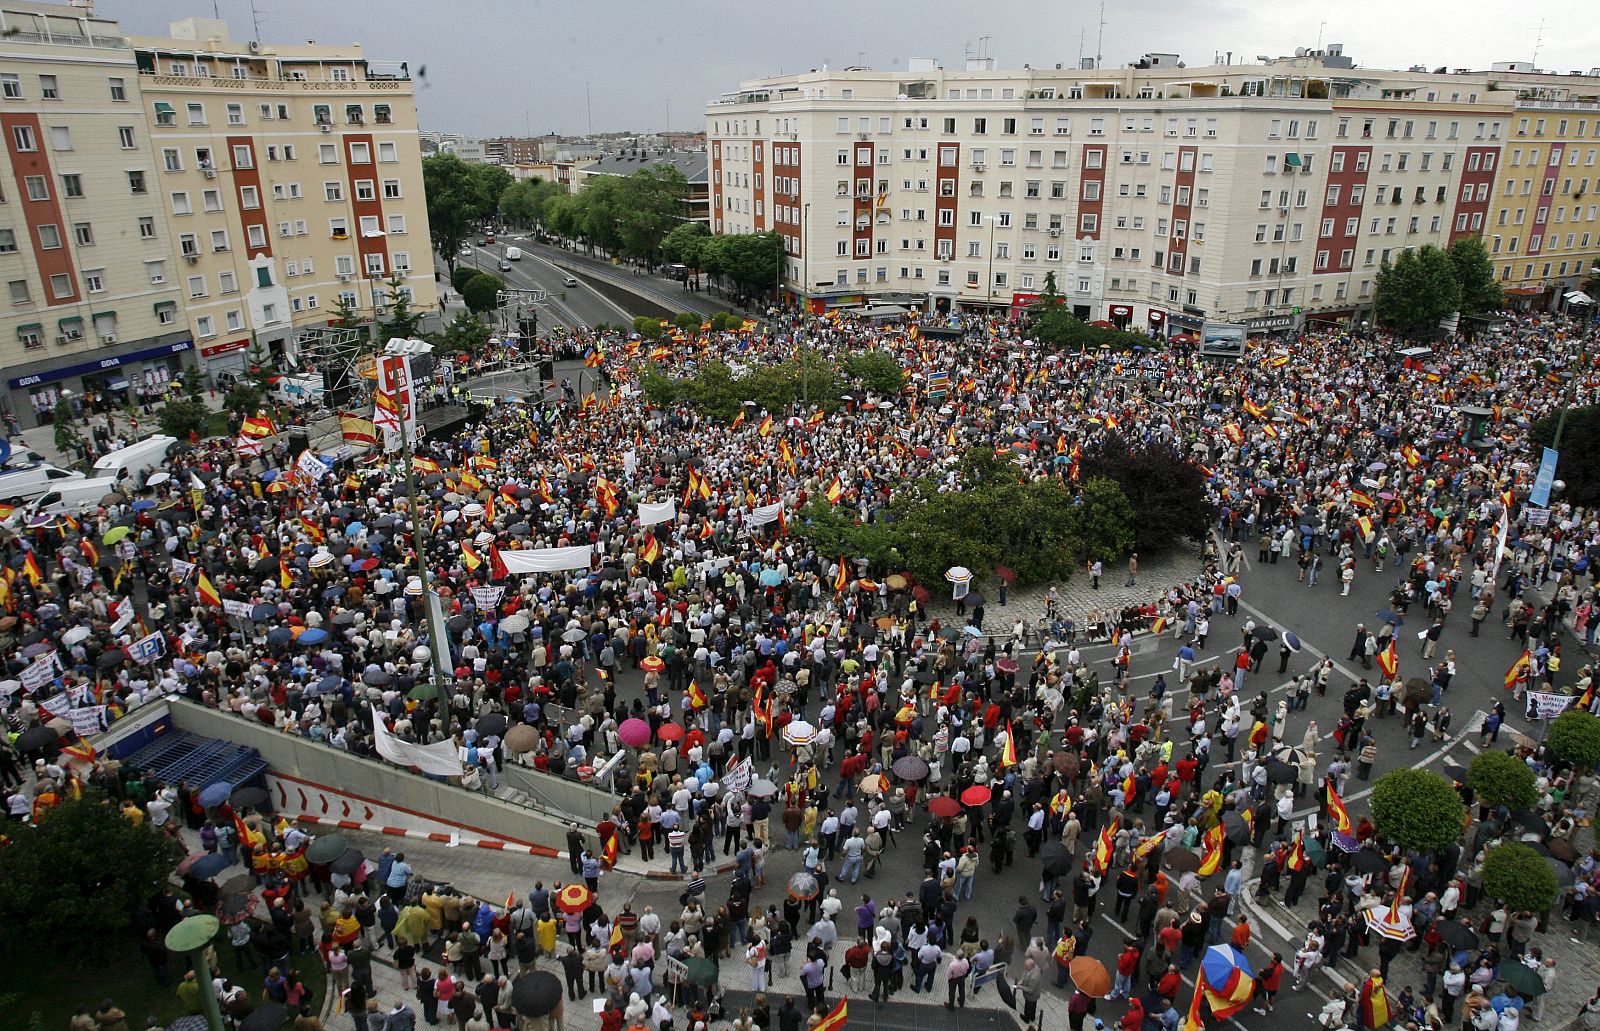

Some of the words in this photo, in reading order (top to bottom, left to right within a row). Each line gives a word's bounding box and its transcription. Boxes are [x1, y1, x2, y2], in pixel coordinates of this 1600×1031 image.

[1250, 318, 1290, 328] FARMACIA
[171, 342, 189, 352] BBVA
[100, 358, 120, 368] BBVA
[19, 375, 41, 386] BBVA
